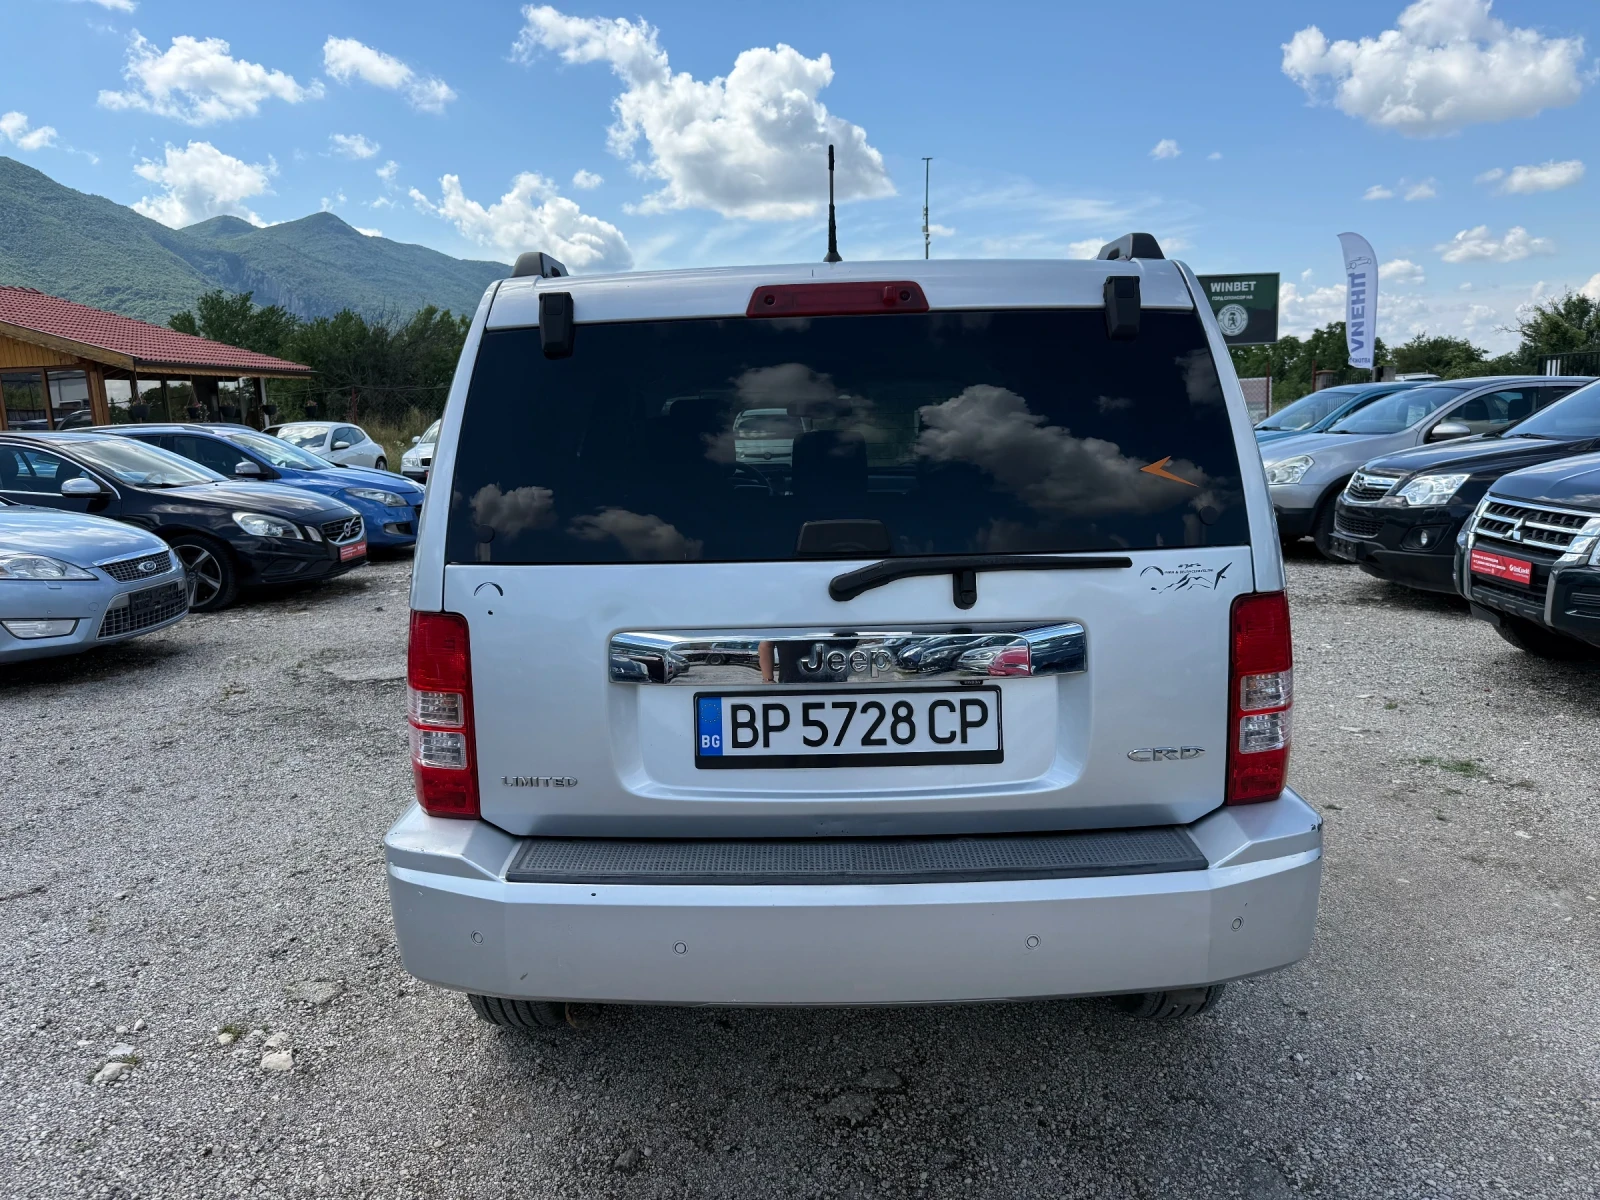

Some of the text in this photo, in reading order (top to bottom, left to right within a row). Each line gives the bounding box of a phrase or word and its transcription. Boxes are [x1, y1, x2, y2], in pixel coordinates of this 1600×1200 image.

[1210, 281, 1256, 293] WINBET
[798, 643, 893, 678] Jeep
[731, 698, 989, 749] BP 5728 CP
[701, 735, 720, 748] BG
[1127, 746, 1206, 762] CRD
[501, 776, 578, 788] LIMITED
